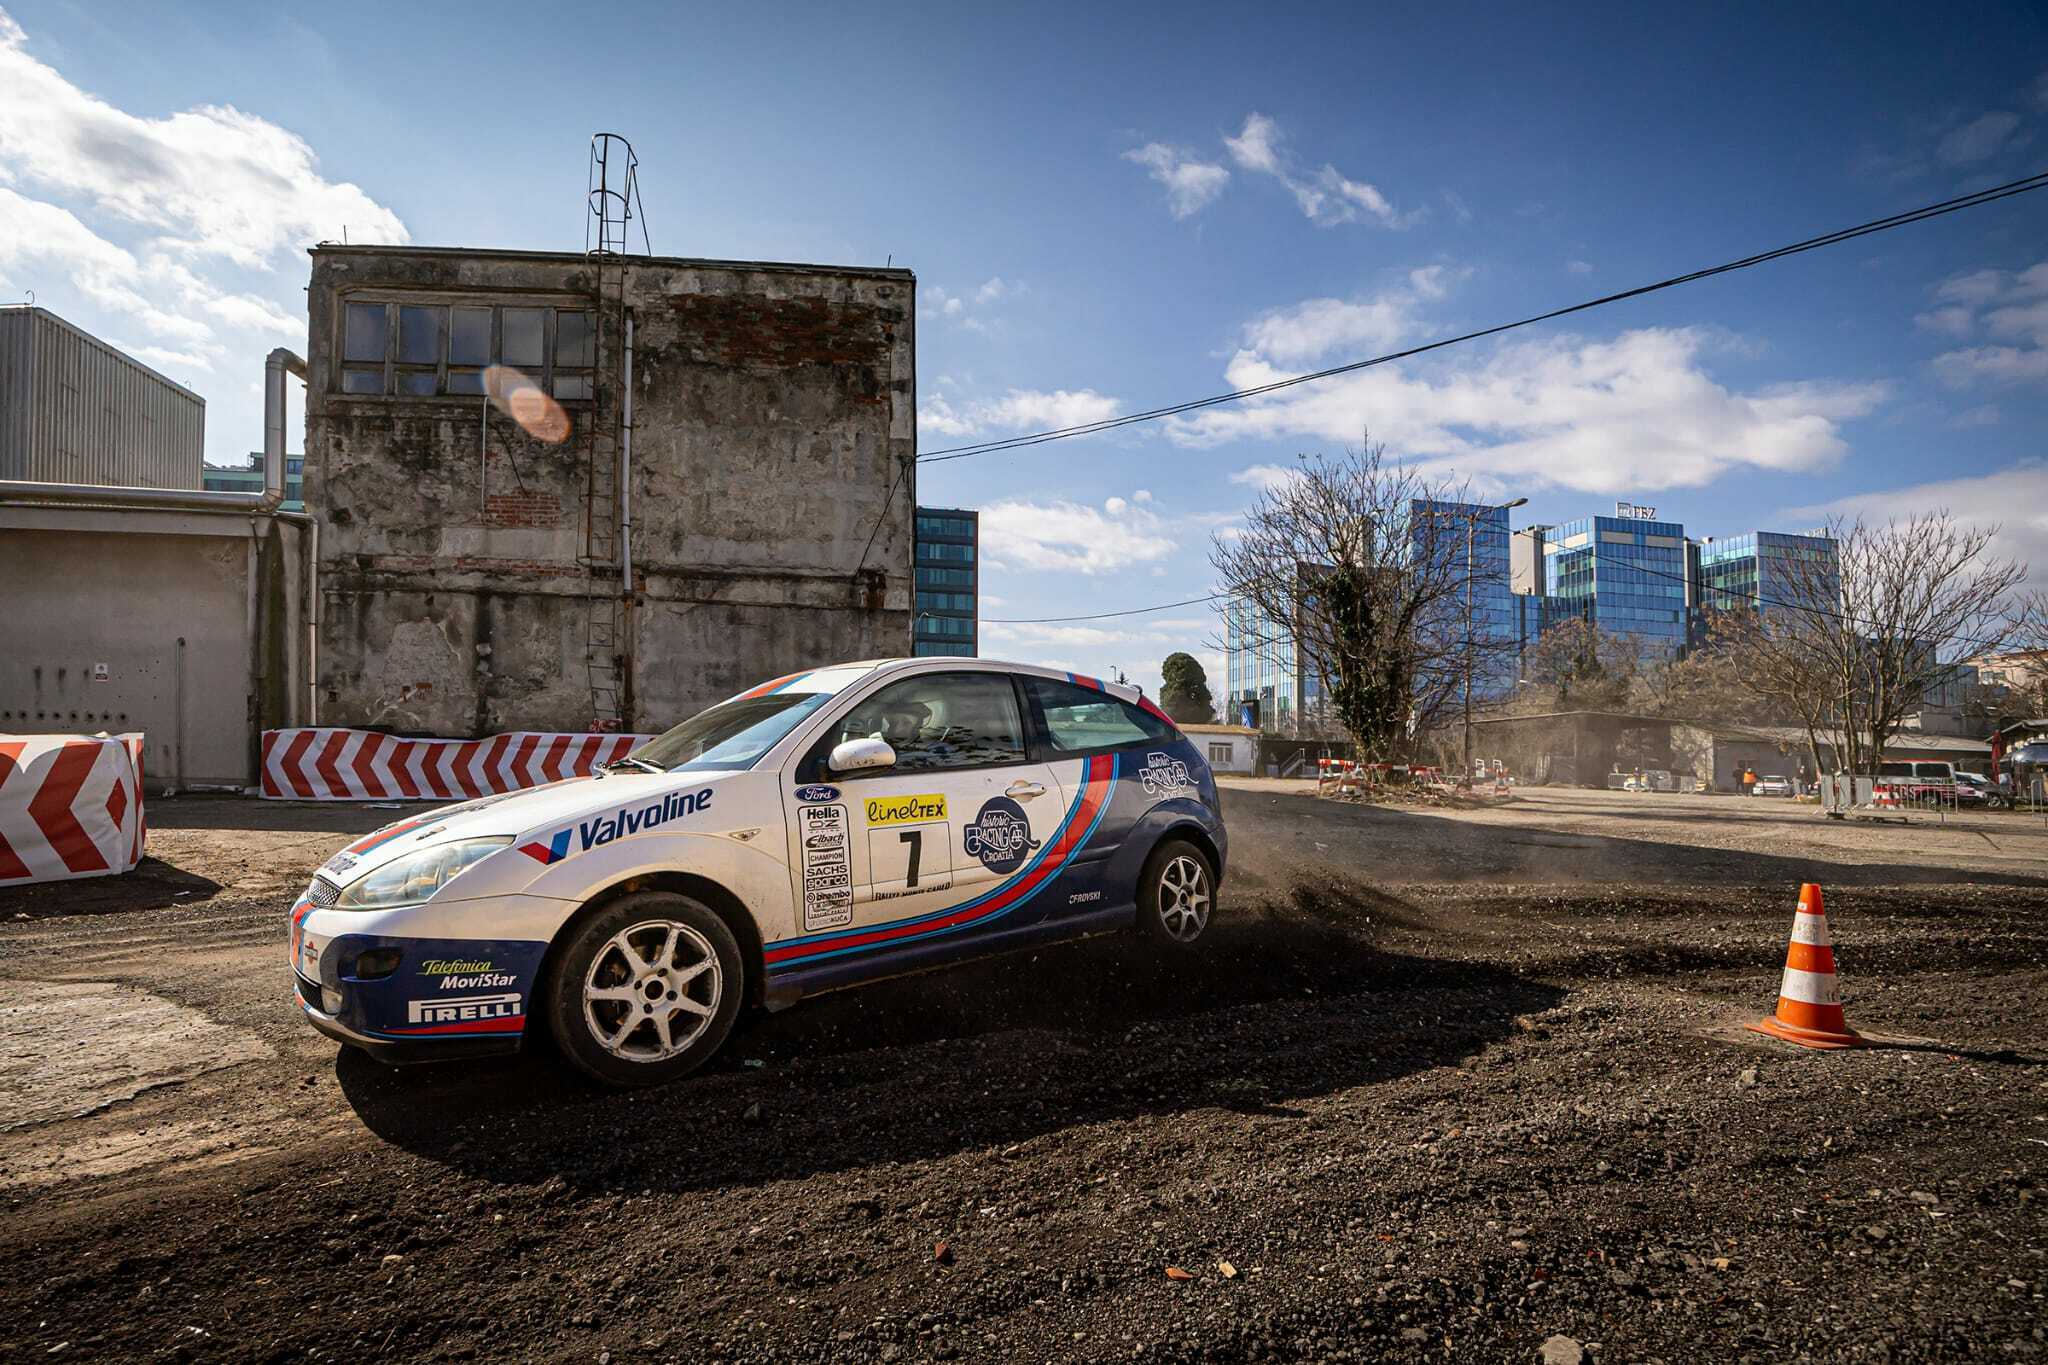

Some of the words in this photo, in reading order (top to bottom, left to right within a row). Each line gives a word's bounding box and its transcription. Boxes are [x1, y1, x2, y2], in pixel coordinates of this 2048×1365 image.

[804, 785, 833, 800] Ford
[579, 788, 713, 851] Valvoline
[807, 807, 840, 820] Hella
[809, 819, 840, 828] OZ
[810, 852, 843, 862] CHAMPION
[900, 831, 922, 888] 7
[983, 847, 1015, 862] CROATIA
[807, 864, 848, 877] SACHS
[807, 875, 849, 891] sparco
[816, 889, 851, 901] brembo
[440, 974, 517, 990] MoviStar
[408, 993, 522, 1023] PIRELLI
